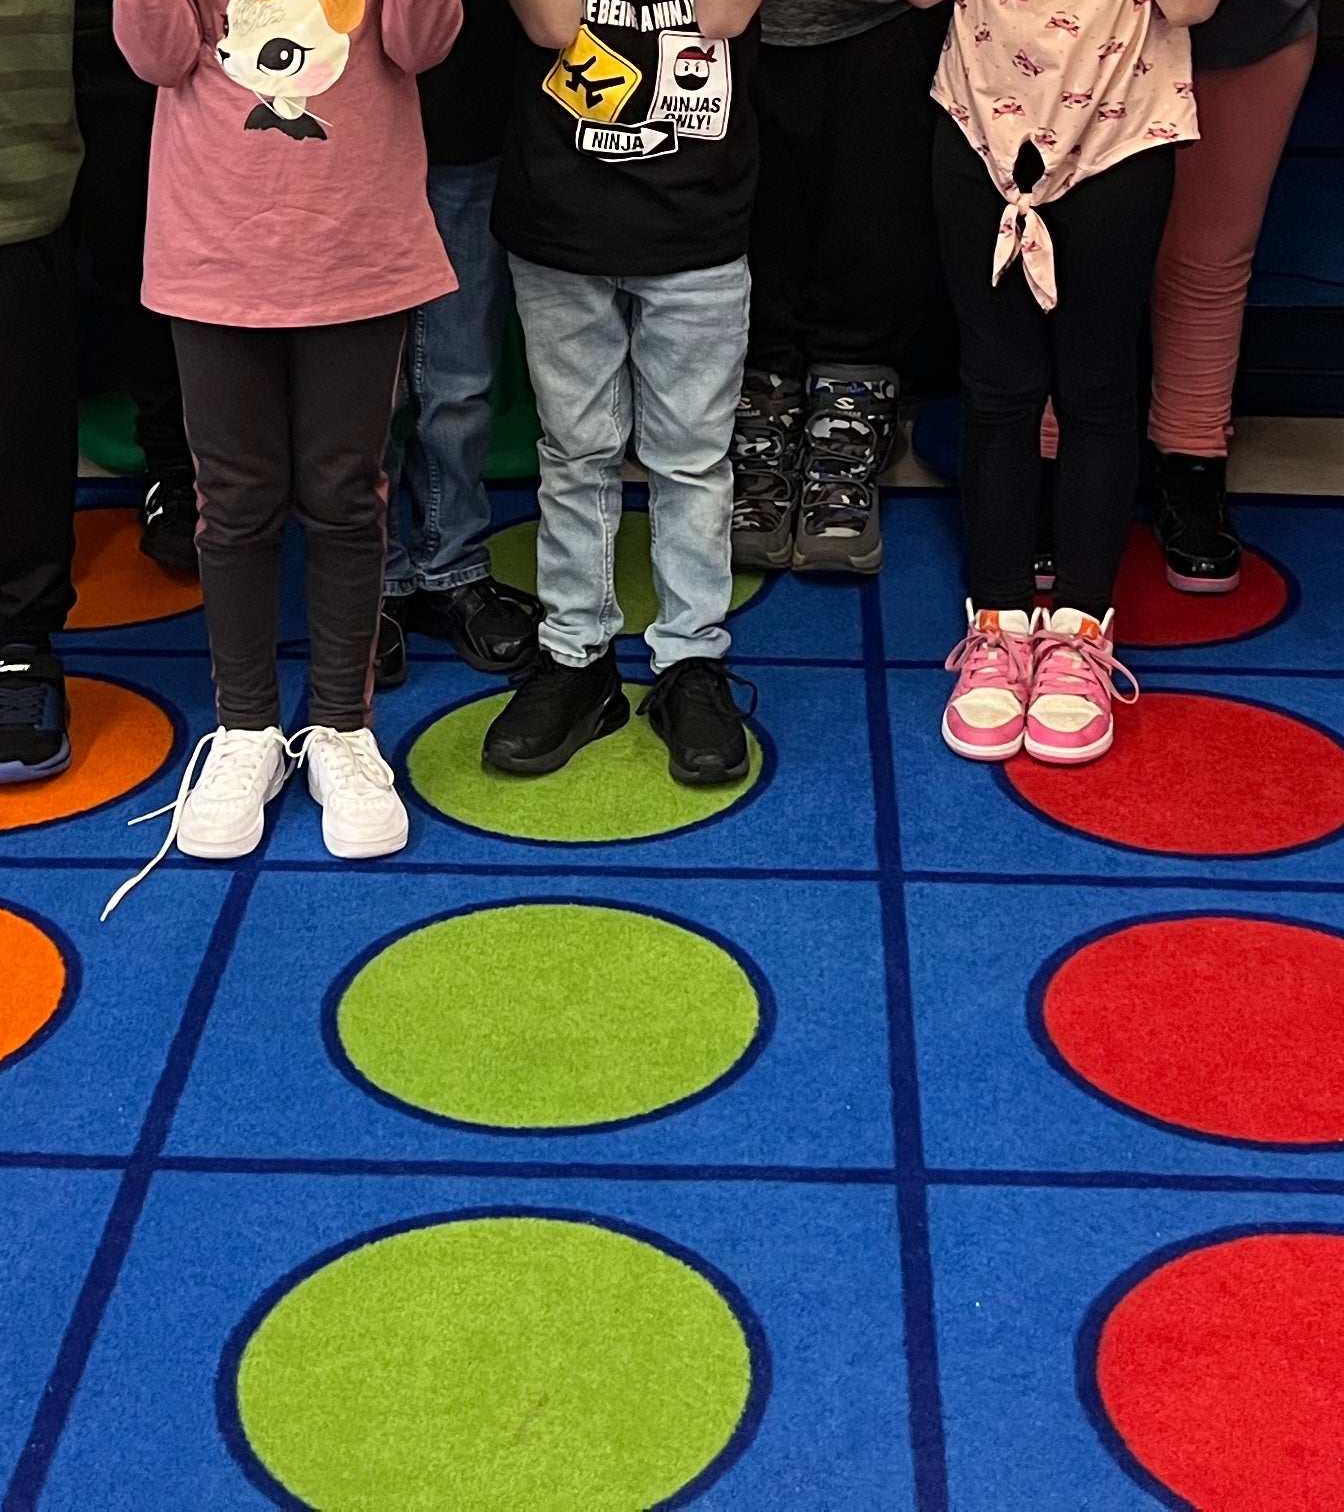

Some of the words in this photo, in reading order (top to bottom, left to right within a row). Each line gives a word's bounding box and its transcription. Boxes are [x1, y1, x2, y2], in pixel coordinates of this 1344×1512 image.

[641, 6, 654, 32] A
[660, 96, 722, 113] NINJAS
[592, 131, 645, 151] NINJA
